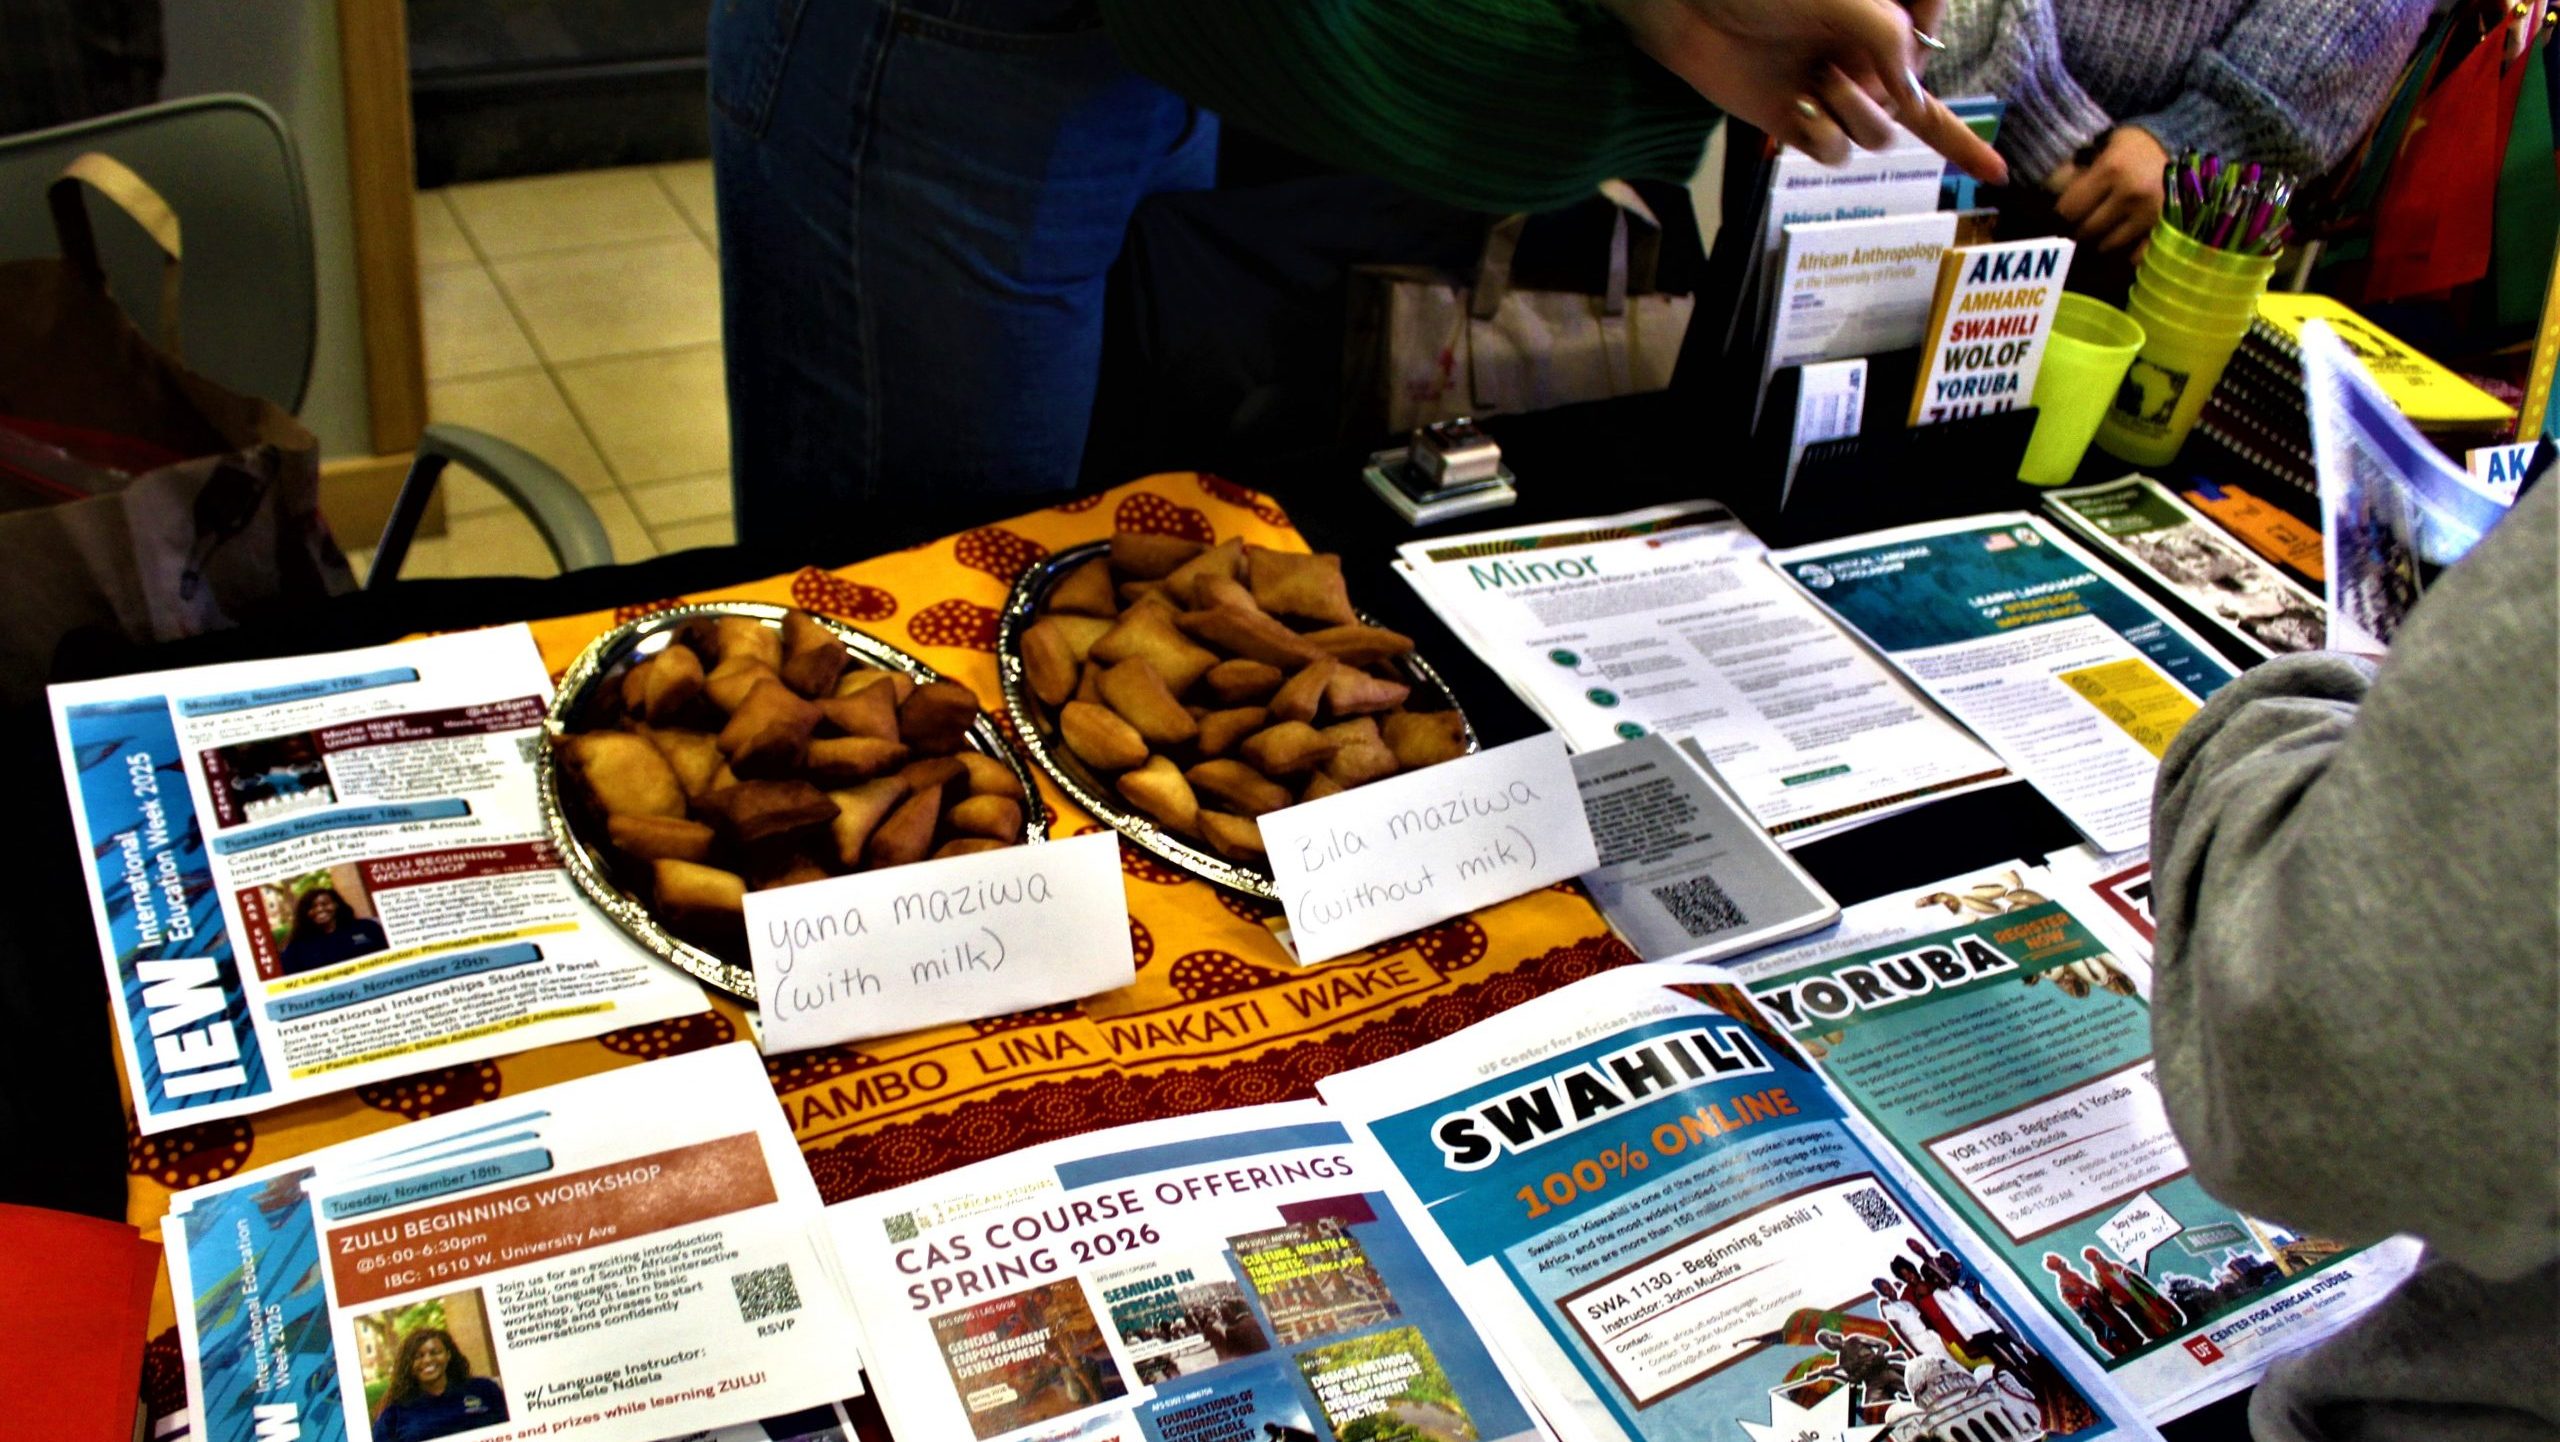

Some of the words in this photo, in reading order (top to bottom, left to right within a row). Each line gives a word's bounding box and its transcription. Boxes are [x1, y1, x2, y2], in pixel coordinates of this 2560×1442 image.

[1797, 252, 1848, 272] African
[1852, 243, 1943, 265] Anthropology
[1825, 271, 1869, 286] University
[1969, 249, 2059, 284] AKAN
[1958, 288, 2047, 314] AMHARIC
[1949, 314, 2038, 343] SWAHILI
[1943, 341, 2030, 374] WOLOF
[1936, 372, 2019, 404] YORUBA
[1468, 555, 1599, 590] Minor
[1506, 576, 1598, 598] Undergraduate
[1600, 570, 1636, 583] Minor
[127, 752, 158, 799] 2025
[139, 798, 168, 848] Week
[228, 846, 287, 865] College
[311, 828, 393, 845] Education:
[430, 818, 481, 829] Annual
[294, 813, 373, 830] November
[1296, 830, 1369, 874] Bila
[1387, 779, 1541, 839] maziwa
[231, 847, 334, 876] International
[338, 842, 366, 850] Fair
[370, 860, 412, 873] ZULU
[415, 850, 506, 867] BEGINNING
[373, 863, 467, 883] WORKSHOP
[1299, 866, 1436, 934] (without
[1457, 825, 1538, 883] mik)
[115, 830, 161, 949] International
[156, 849, 194, 943] Education
[769, 908, 868, 974] yana
[893, 873, 1052, 924] maziwa
[1993, 913, 2071, 944] REGISTER
[2025, 930, 2065, 949] NOW
[279, 990, 359, 1014] Thursday,
[363, 962, 447, 993] November
[451, 955, 489, 970] 20th
[774, 970, 881, 1021] (with
[911, 927, 1005, 986] milk)
[1758, 940, 2008, 1027] YORUBA
[277, 1005, 388, 1036] International
[392, 978, 484, 1008] Internships
[489, 966, 552, 985] Student
[557, 960, 600, 972] Panel
[971, 1030, 1088, 1075] LINA
[1105, 999, 1269, 1056] WAKATI
[1283, 960, 1420, 1020] WAKE
[137, 957, 246, 1098] IEW
[1478, 1062, 1496, 1074] UF
[1501, 1045, 1549, 1066] Center
[1551, 1036, 1572, 1048] for
[1576, 1017, 1628, 1040] African
[1629, 1004, 1678, 1021] Studies
[1439, 1032, 1766, 1164] SWAHILI
[1947, 1142, 1981, 1162] YOR
[1980, 1129, 2013, 1150] 1130
[2018, 1106, 2083, 1136] Beginning
[2079, 1099, 2089, 1112] 1
[2088, 1086, 2132, 1110] Yoruba
[1516, 1143, 1649, 1219] 100%
[1651, 1088, 1799, 1155] ONLINE
[330, 1192, 391, 1213] Tuesday,
[396, 1172, 465, 1198] November
[469, 1165, 501, 1184] 18th
[341, 1228, 398, 1254] ZULU
[405, 1193, 532, 1238] BEGINNING
[537, 1166, 661, 1207] WORKSHOP
[895, 1235, 971, 1275] CAS
[985, 1189, 1144, 1249] COURSE
[1155, 1155, 1354, 1205] OFFERINGS
[1566, 1258, 1599, 1278] There
[1601, 1250, 1618, 1261] are
[1620, 1236, 1648, 1253] more
[1648, 1223, 1673, 1240] than
[1674, 1212, 1694, 1228] 150
[1696, 1196, 1731, 1217] million
[2129, 1210, 2150, 1222] Hello
[237, 1218, 257, 1295] Education
[356, 1232, 487, 1274] @5:00-6:30pm
[384, 1271, 421, 1289] IBC:
[429, 1259, 469, 1278] 1510
[474, 1251, 498, 1266] W.
[502, 1230, 583, 1260] University
[589, 1224, 616, 1241] Ave
[496, 1280, 524, 1294] Join
[529, 1277, 544, 1285] us
[548, 1268, 566, 1281] for
[570, 1265, 587, 1275] an
[590, 1251, 640, 1272] exciting
[644, 1231, 722, 1256] introduction
[908, 1248, 1058, 1311] SPRING
[1071, 1223, 1160, 1264] 2026
[1588, 1294, 1630, 1320] SWA
[1630, 1272, 1672, 1299] 1130
[1683, 1230, 1763, 1275] Beginning
[1759, 1211, 1813, 1239] Swahili
[1813, 1205, 1823, 1217] 1
[1104, 1274, 1174, 1302] SEMINAR
[1176, 1268, 1194, 1284] IN
[1601, 1300, 1665, 1334] Instructor:
[1664, 1285, 1695, 1305] John
[1694, 1262, 1741, 1291] Muchira
[2210, 1319, 2250, 1343] CENTER
[2250, 1310, 2270, 1324] FOR
[2271, 1289, 2313, 1314] AFRICAN
[2311, 1270, 2352, 1294] STUDIES
[249, 1295, 269, 1393] International
[265, 1304, 283, 1345] 2025
[757, 1319, 795, 1338] RSVP
[948, 1331, 997, 1354] GENDER
[267, 1345, 290, 1388] Week
[952, 1328, 1051, 1367] EMPOWERMENT
[957, 1342, 1046, 1379] DEVELOPMENT
[1312, 1366, 1357, 1388] DESIGN
[1358, 1351, 1414, 1373] METHODS
[2192, 1341, 2212, 1358] UF
[523, 1387, 544, 1400] w/
[548, 1368, 620, 1394] Language
[625, 1349, 706, 1376] Instructor:
[528, 1382, 608, 1412] Phumelele
[613, 1372, 662, 1391] Ndlela
[1318, 1385, 1343, 1401] FOR
[1342, 1361, 1422, 1392] SUSTAINABLE
[1325, 1379, 1409, 1413] DEVELOPMENT
[518, 1422, 547, 1439] and
[553, 1412, 600, 1433] prizes
[604, 1399, 646, 1419] while
[650, 1385, 715, 1409] learning
[718, 1372, 766, 1391] ZULU!
[1156, 1395, 1238, 1427] FOUNDATIONS
[1240, 1389, 1252, 1400] OF
[1162, 1410, 1231, 1439] ECONOMICS
[1232, 1403, 1255, 1416] FOR
[1330, 1399, 1389, 1427] PRACTICE
